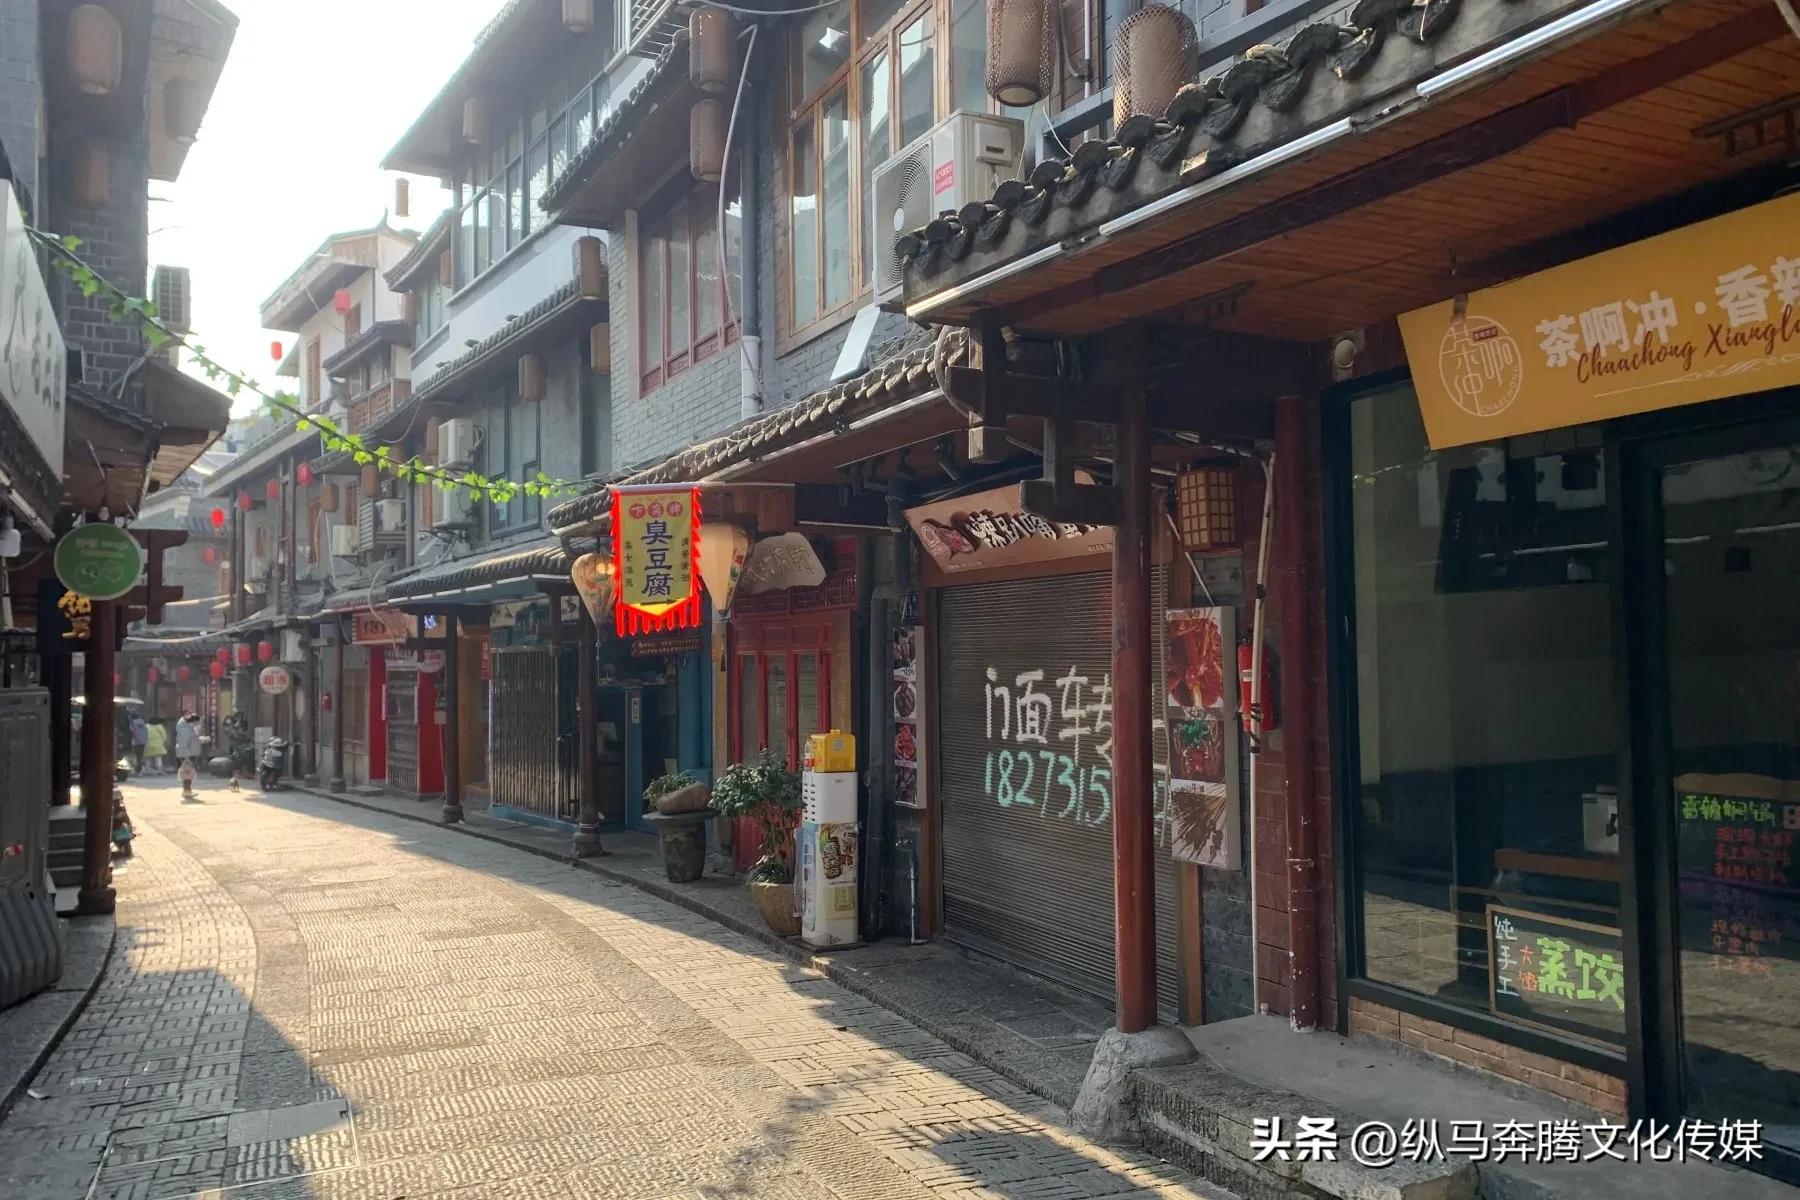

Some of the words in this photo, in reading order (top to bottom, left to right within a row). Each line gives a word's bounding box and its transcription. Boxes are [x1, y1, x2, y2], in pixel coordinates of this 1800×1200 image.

[1577, 330, 1697, 383] Chaachong
[641, 520, 674, 596] 臭豆腐
[984, 665, 1167, 767] 门面转
[984, 750, 1112, 826] 1827315
[1494, 915, 1520, 997] 纯手工
[1536, 936, 1625, 1012] 蒸饺
